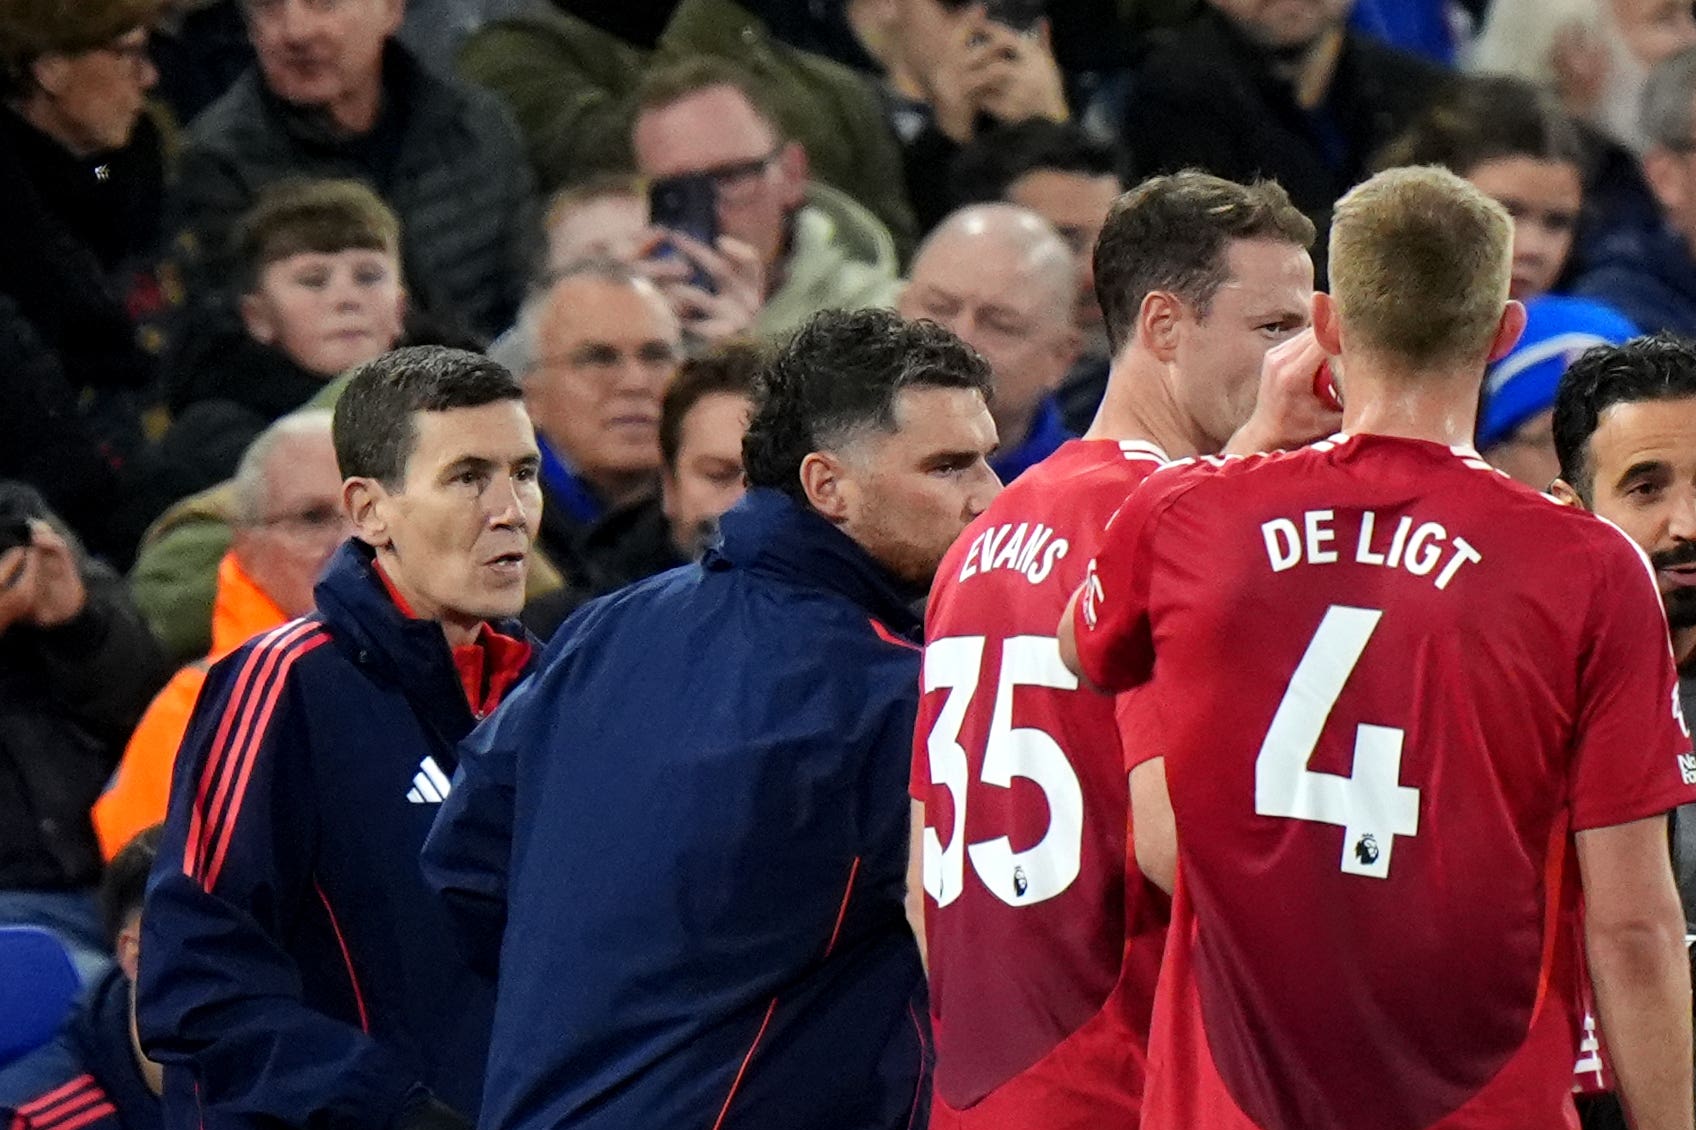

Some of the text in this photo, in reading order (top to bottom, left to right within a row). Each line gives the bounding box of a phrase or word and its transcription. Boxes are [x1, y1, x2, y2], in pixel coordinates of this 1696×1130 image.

[959, 522, 1069, 584] EVANS
[1261, 509, 1482, 590] DE LIGT
[924, 634, 1084, 908] 35
[1255, 604, 1420, 879] 4
